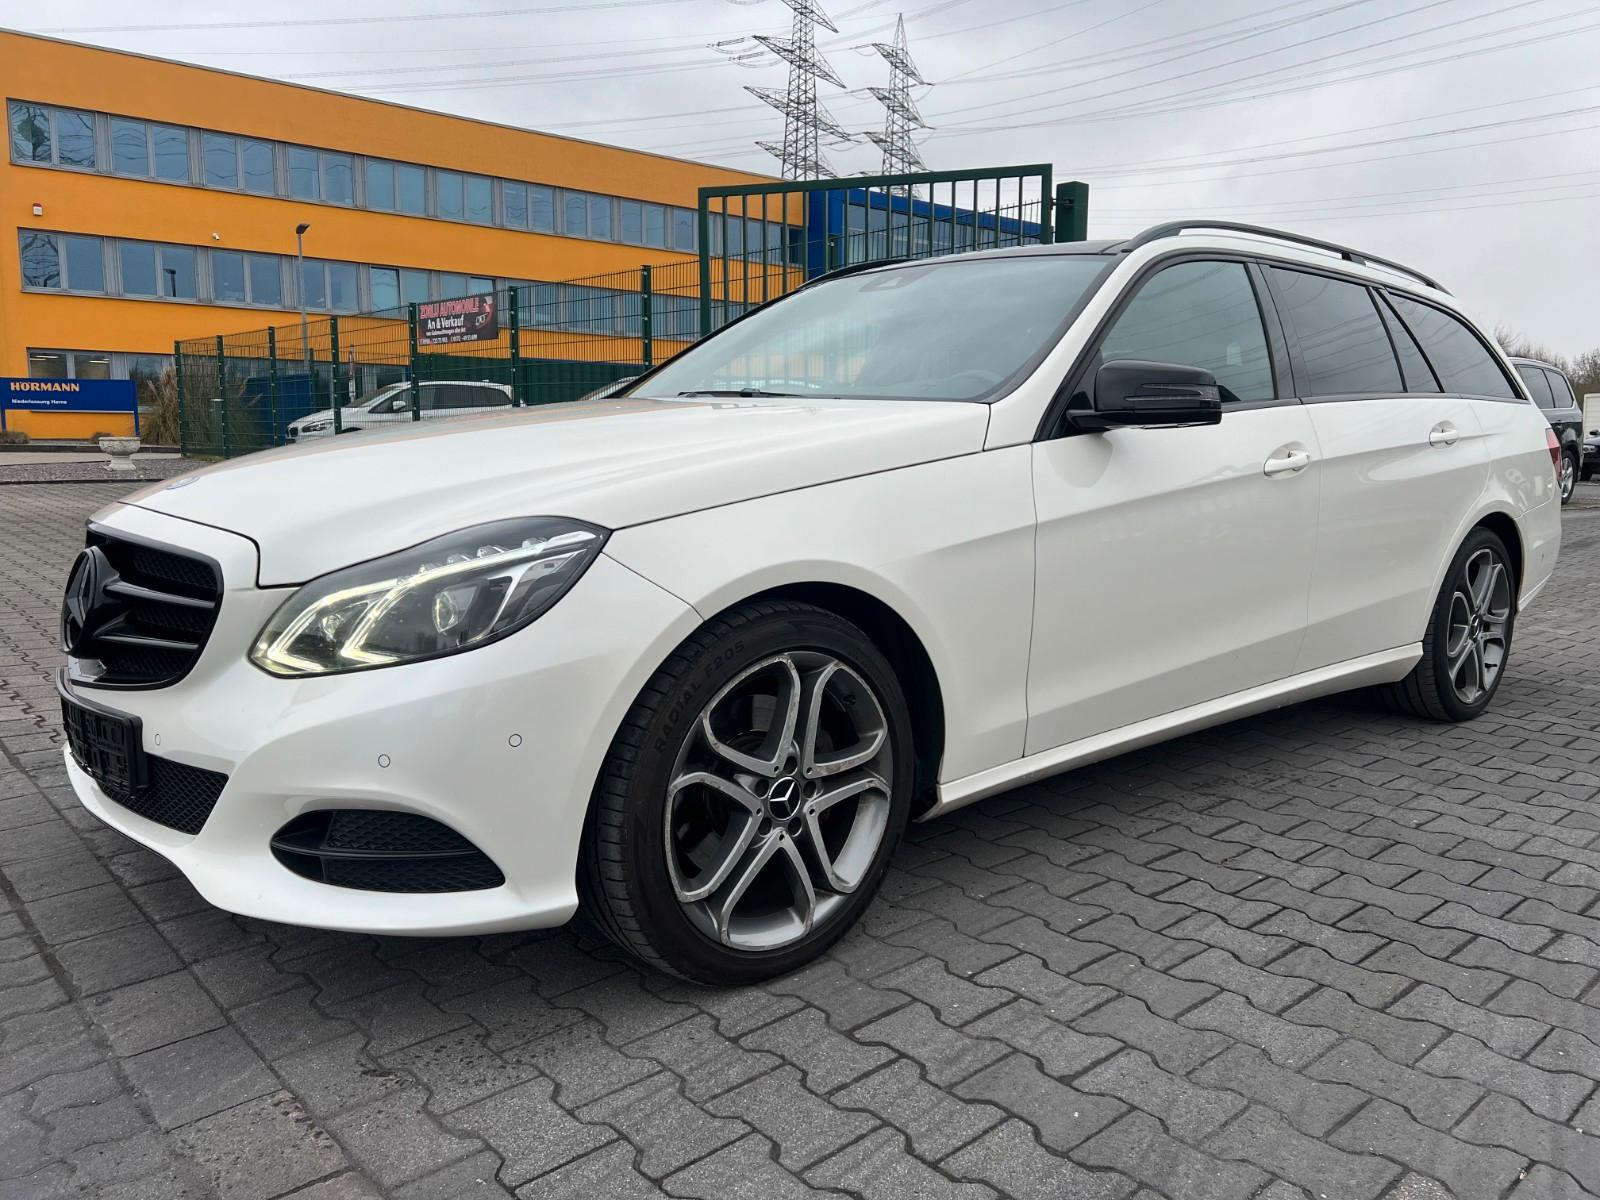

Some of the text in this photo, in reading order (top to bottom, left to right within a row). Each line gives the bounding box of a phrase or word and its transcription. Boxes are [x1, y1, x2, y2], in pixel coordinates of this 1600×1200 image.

[440, 297, 480, 317] AUTOMOBILE
[427, 319, 436, 330] An
[441, 314, 465, 328] Verkauf
[10, 381, 80, 392] HÖRMANN
